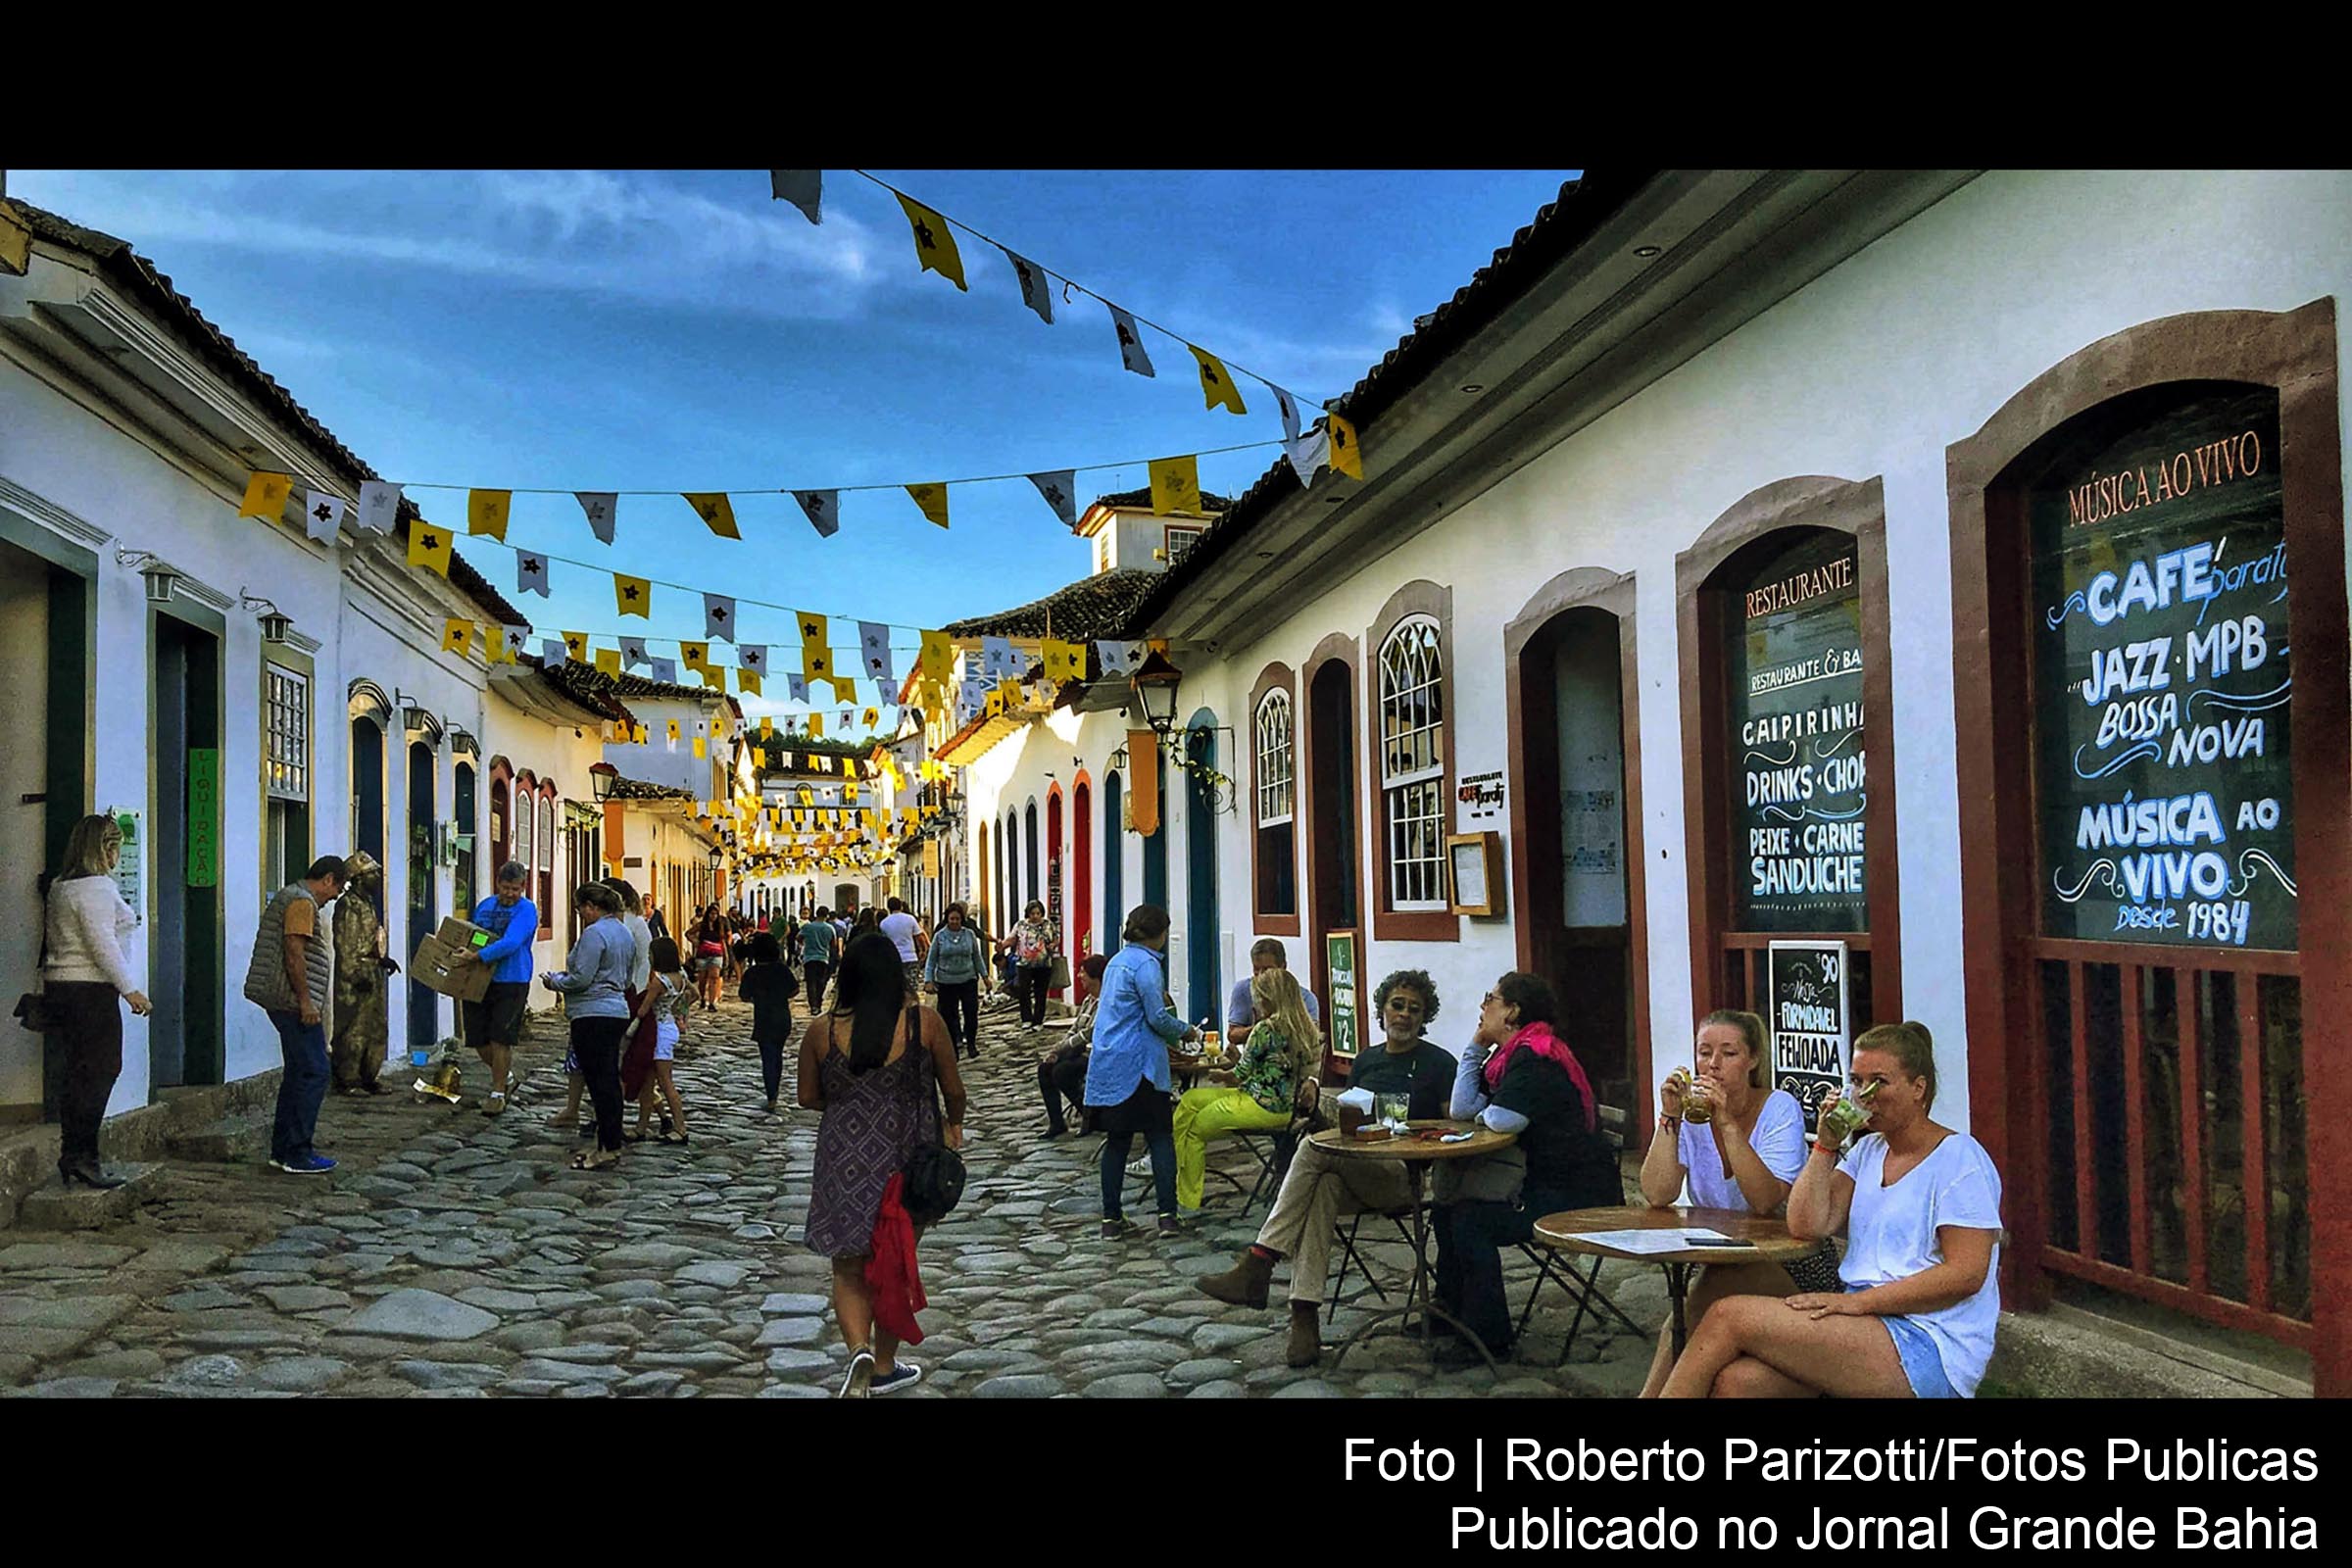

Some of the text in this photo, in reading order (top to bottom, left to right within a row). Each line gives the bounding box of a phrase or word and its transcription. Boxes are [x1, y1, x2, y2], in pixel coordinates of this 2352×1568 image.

[2069, 430, 2261, 528] MÚSICA AO VIVO
[1745, 557, 1853, 619] RESTAURANTE
[1751, 659, 1821, 693] RESTAURANTE
[1824, 647, 1840, 677] &
[2082, 614, 2268, 707] JAZZ MPB
[2095, 692, 2179, 751] BOSSA
[2166, 715, 2266, 769] NOVA
[1745, 763, 1814, 808] DRINKS
[1749, 820, 1866, 858] PEIXE CARNE
[2076, 788, 2281, 851] MÚSICA AO
[1750, 852, 1865, 897] SANDUÍCHE
[2120, 850, 2230, 905] VIVO
[2186, 900, 2251, 946] 1984
[1778, 1033, 1843, 1076] FEIJOADA
[1802, 1085, 1813, 1104] 2
